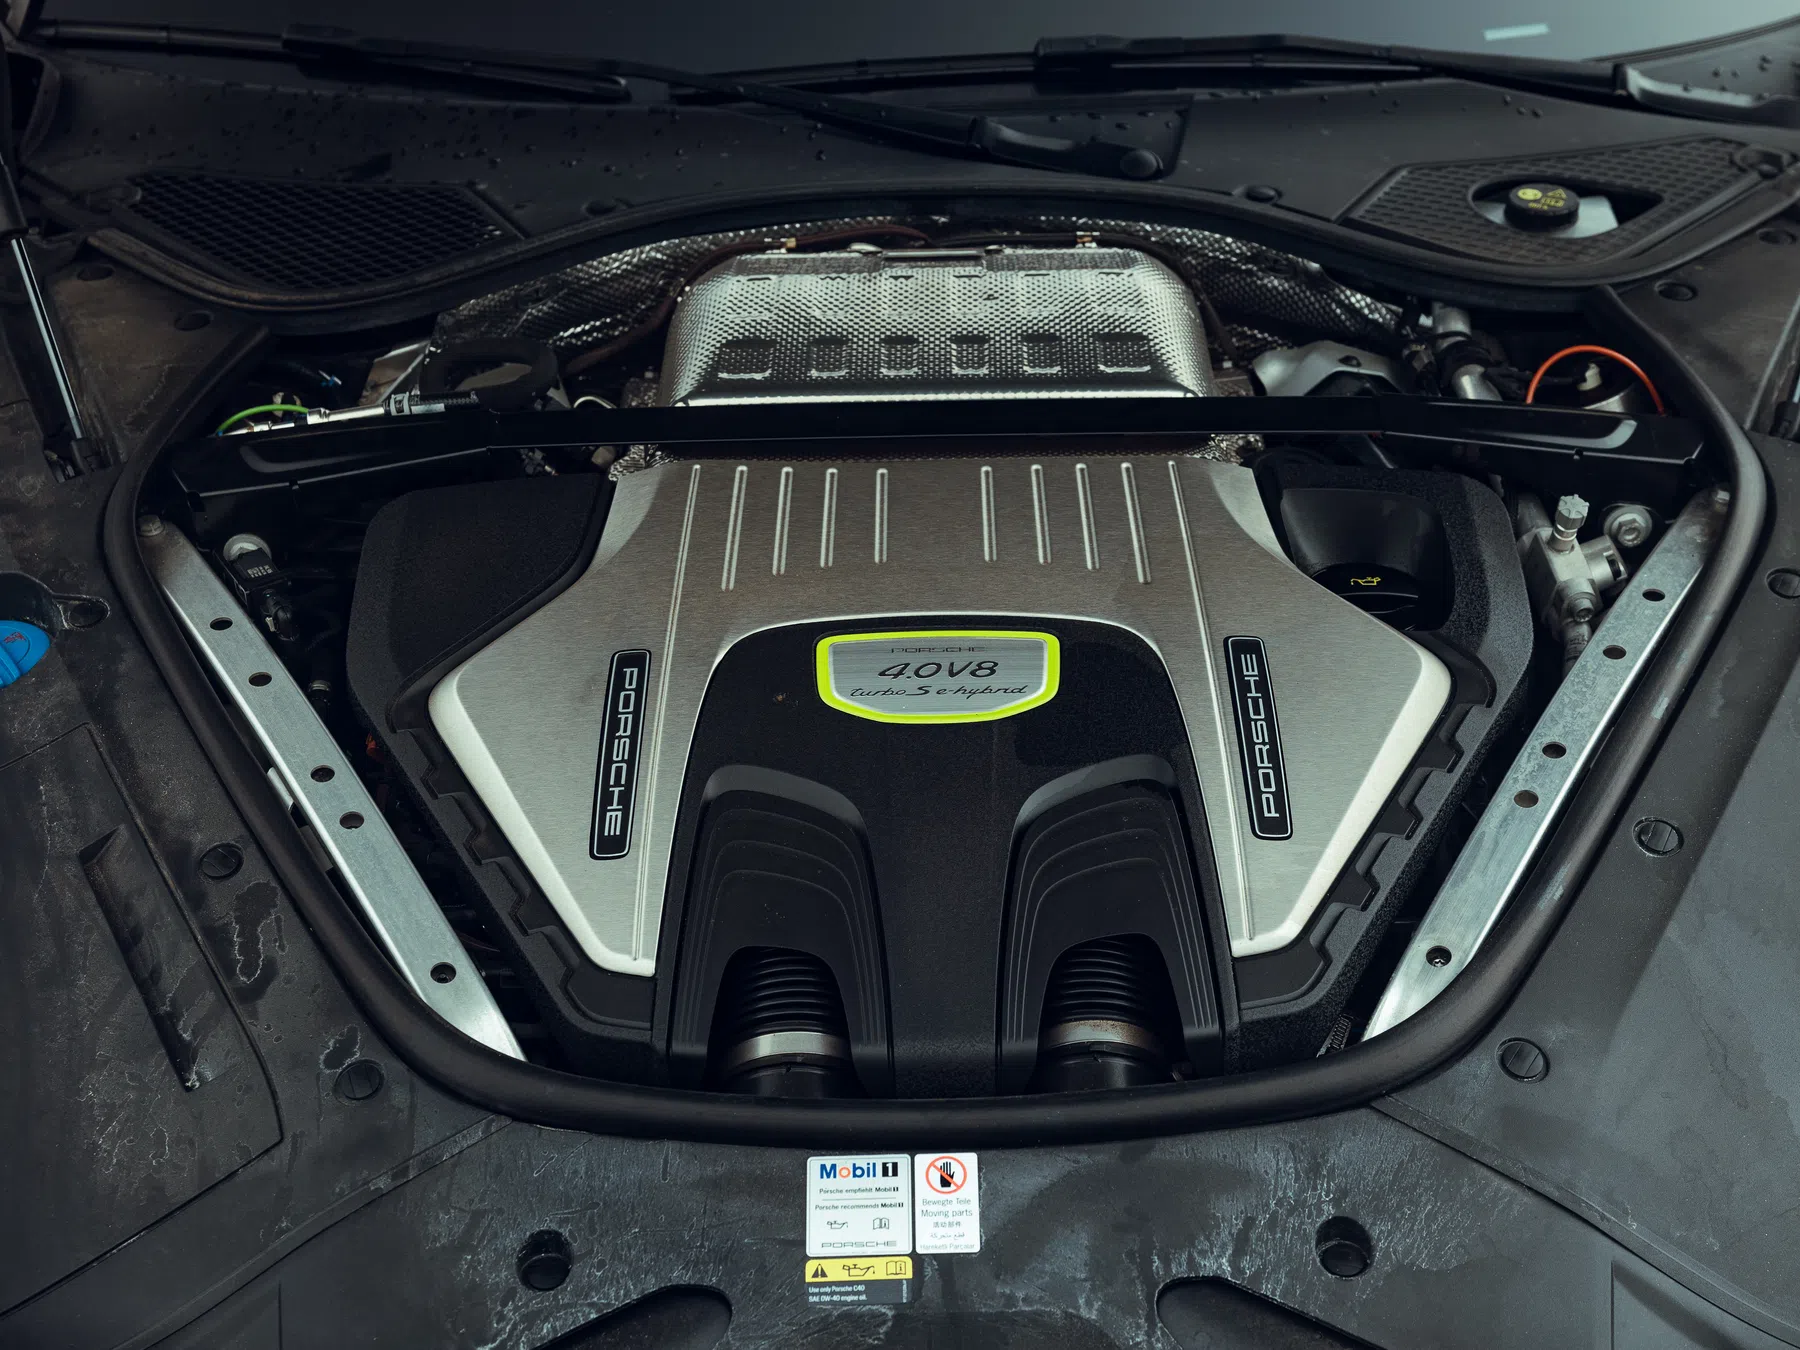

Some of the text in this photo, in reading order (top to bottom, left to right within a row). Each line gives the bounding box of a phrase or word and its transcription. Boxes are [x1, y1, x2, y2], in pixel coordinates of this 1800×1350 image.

[936, 685, 1029, 700] e-hybrid
[1240, 653, 1280, 818] PORSCHE
[604, 668, 639, 836] PORSCHE
[820, 1162, 898, 1179] Mobil 1
[922, 1197, 971, 1206] Bewegte Teile
[921, 1209, 973, 1218] Moving parts
[821, 1240, 897, 1248] PORSCHE
[808, 1295, 820, 1303] SAE
